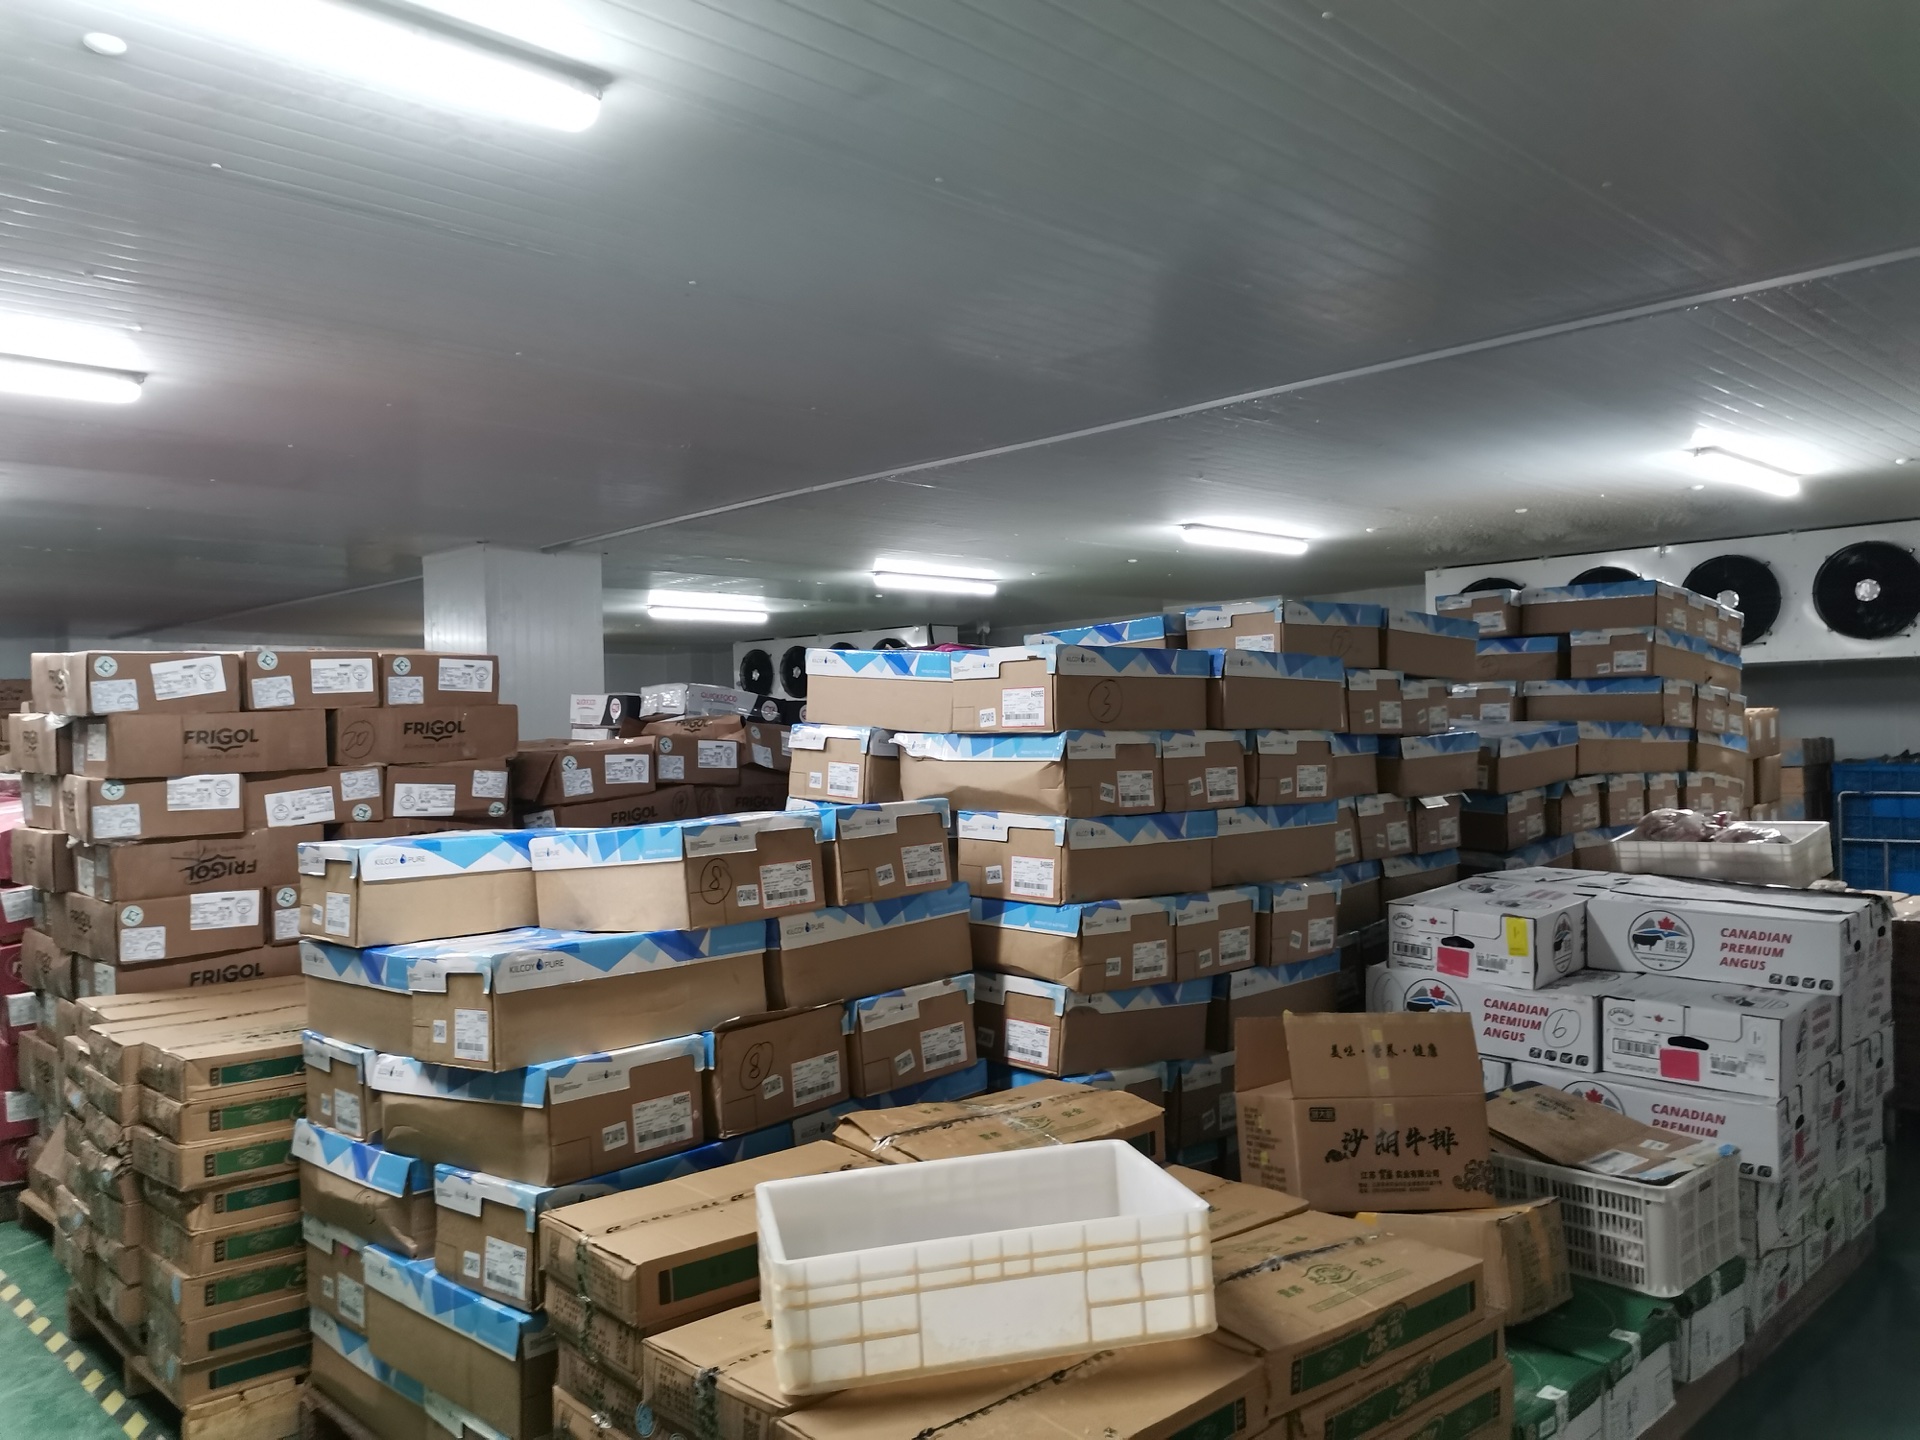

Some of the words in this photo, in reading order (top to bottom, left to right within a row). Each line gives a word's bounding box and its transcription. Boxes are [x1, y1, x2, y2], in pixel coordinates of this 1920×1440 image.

[184, 727, 260, 746] FRIGOL
[403, 719, 466, 736] FRIGOL
[611, 805, 659, 825] FRIGOL
[183, 859, 258, 881] FRIGOL
[374, 857, 399, 867] KILCOY
[408, 855, 426, 865] PURE
[709, 865, 722, 891] 8
[810, 922, 826, 932] PURE
[1720, 927, 1793, 944] CANADIAN
[1720, 942, 1785, 958] PREMIUM
[509, 963, 535, 974] KILCOY
[544, 958, 565, 968] PURE
[1719, 956, 1767, 971] ANGUS
[190, 962, 265, 987] FRIGOL
[1483, 998, 1549, 1017] CANADIAN
[1483, 1012, 1542, 1031] PREMIUM
[1552, 1013, 1568, 1039] 6
[1483, 1027, 1526, 1042] ANGUS
[750, 1053, 761, 1079] 8
[1651, 1103, 1727, 1126] CANADIAN
